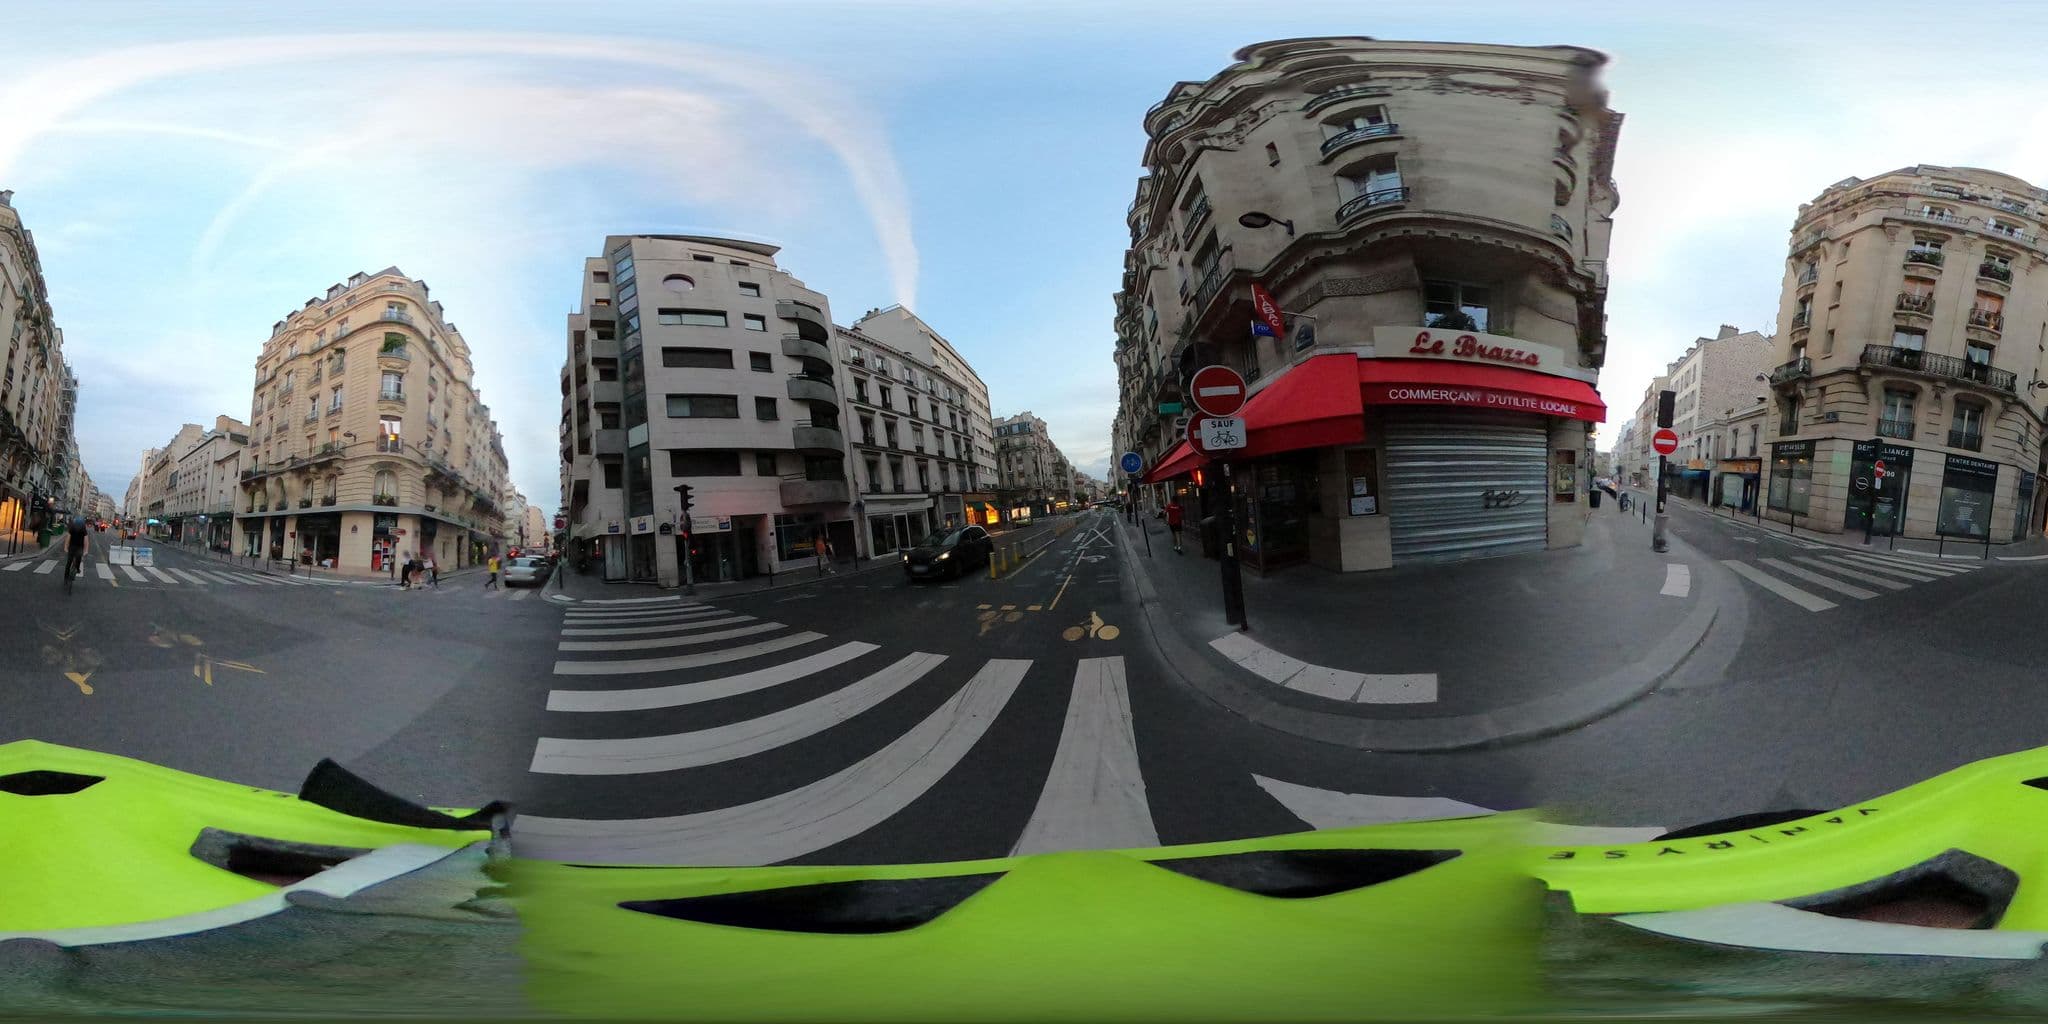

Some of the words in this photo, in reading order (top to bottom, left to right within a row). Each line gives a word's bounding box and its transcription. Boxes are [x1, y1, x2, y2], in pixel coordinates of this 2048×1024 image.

[1258, 294, 1280, 327] TABAC
[1409, 331, 1445, 354] Le
[1452, 334, 1540, 366] Brazza
[1540, 401, 1577, 414] LOCALE
[1211, 420, 1234, 428] SAUF
[1949, 457, 1970, 466] CENTRE
[1970, 460, 1996, 470] DENTAIRE
